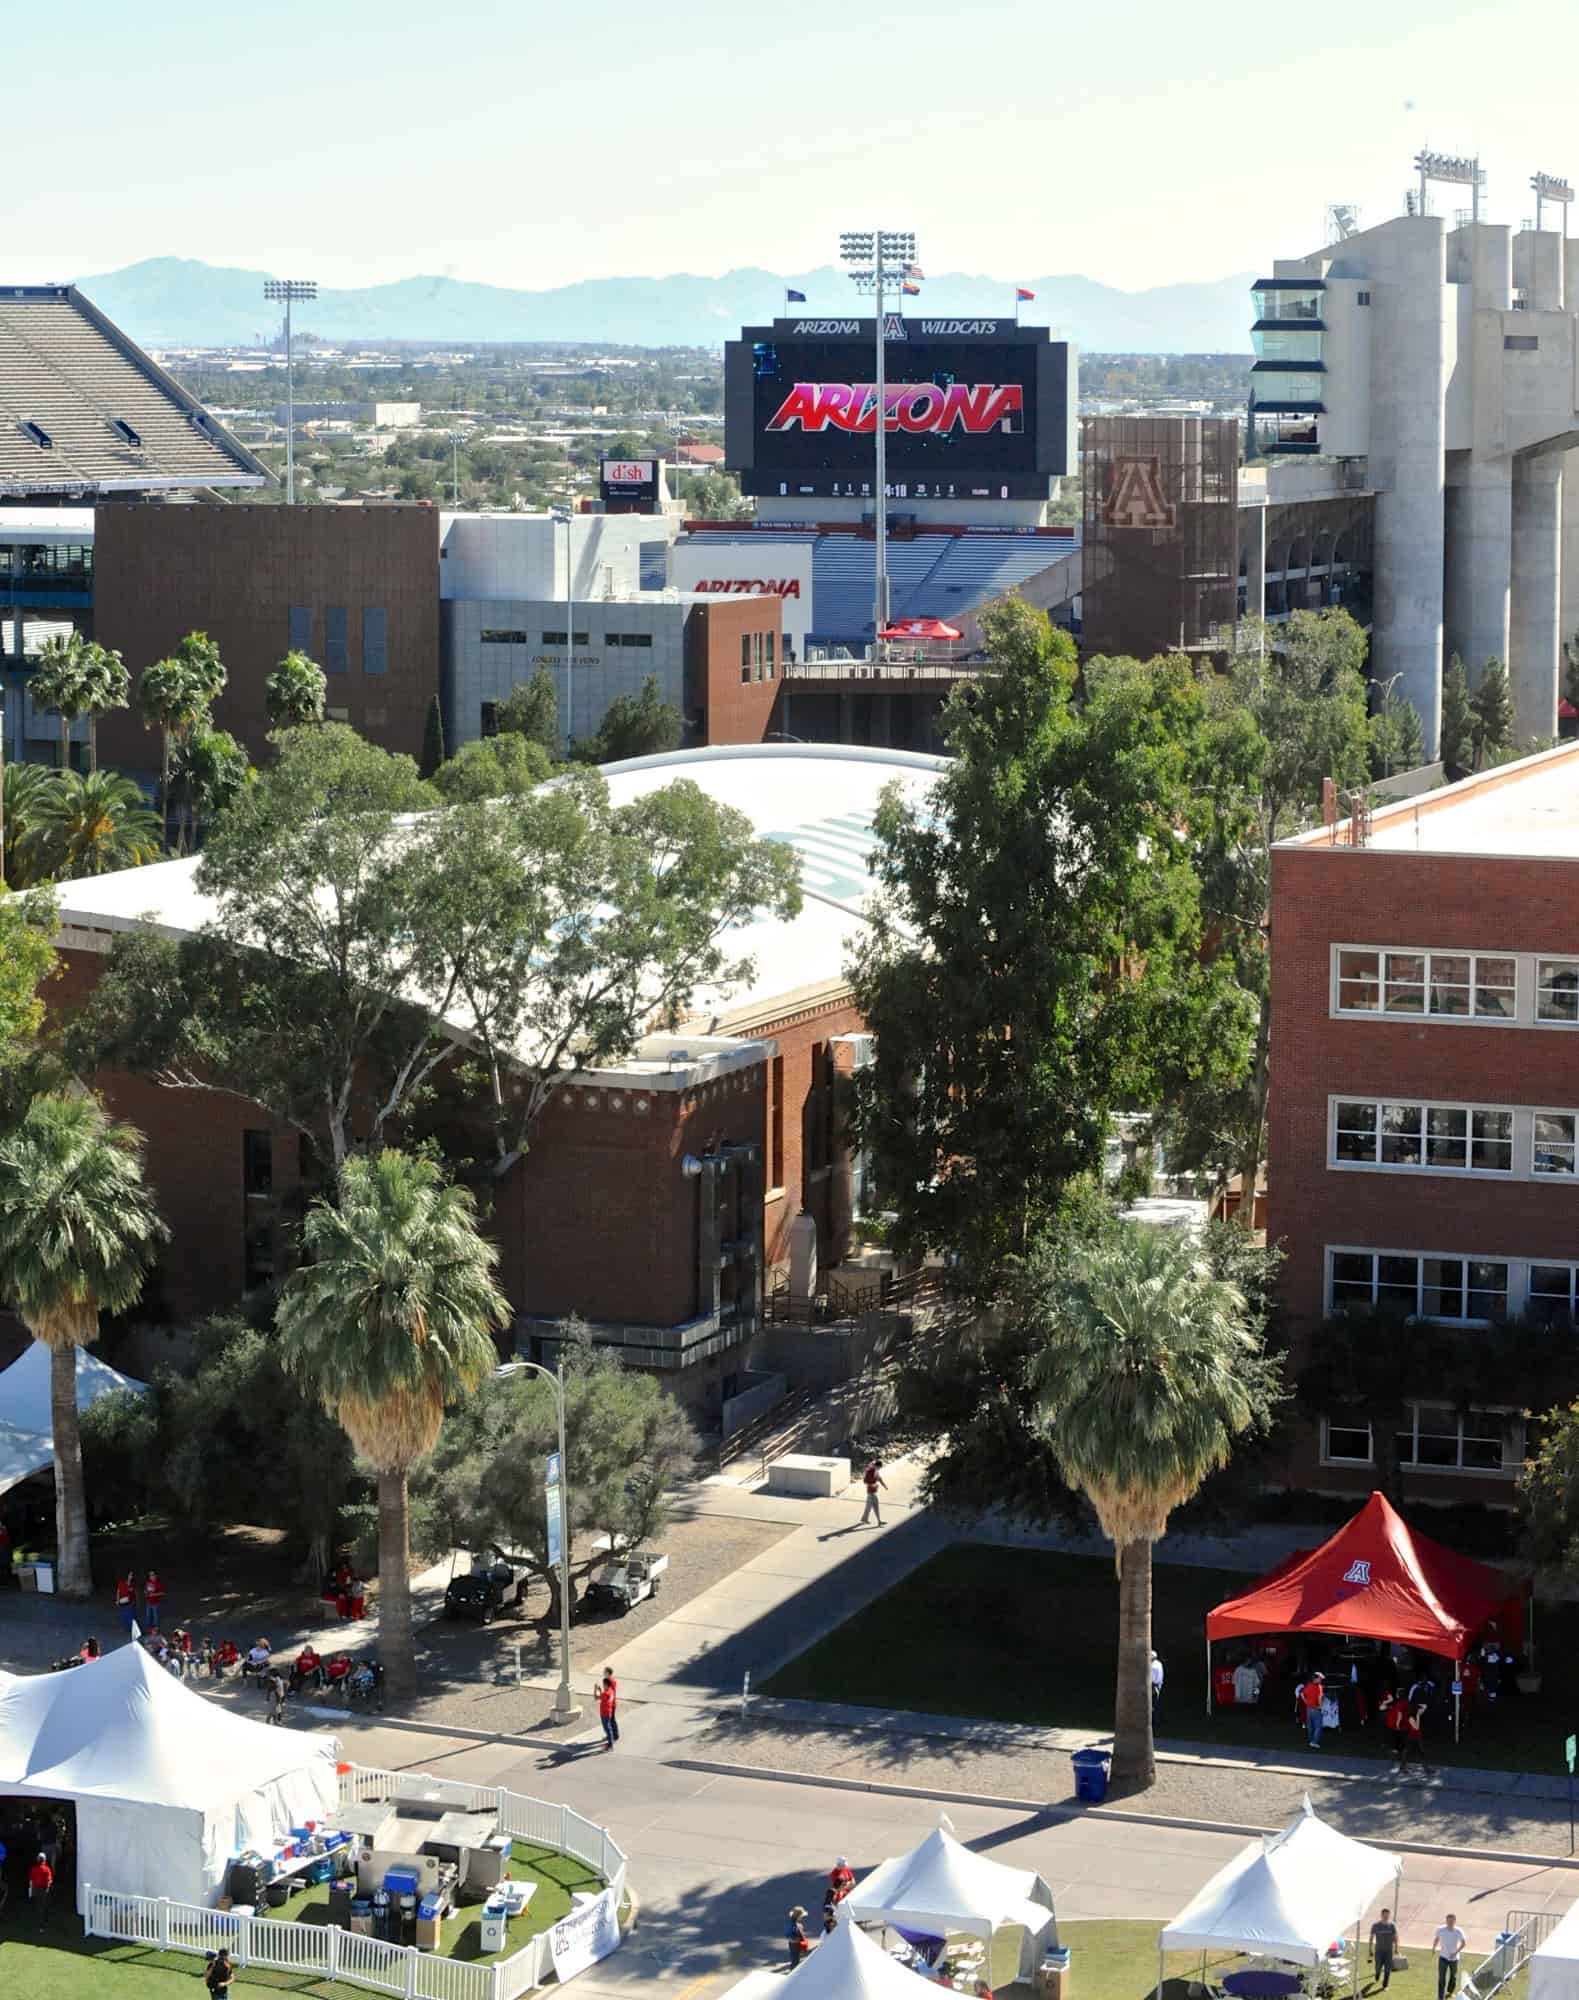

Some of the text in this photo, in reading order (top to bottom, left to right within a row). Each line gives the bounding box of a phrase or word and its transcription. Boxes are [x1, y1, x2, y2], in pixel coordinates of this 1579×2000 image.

[793, 321, 860, 334] ARIZONA
[921, 321, 997, 334] WILDCATS
[765, 383, 1025, 432] ARIZONA
[613, 464, 642, 480] dish
[1103, 455, 1176, 529] A
[694, 579, 801, 600] ARIZONA
[1344, 1560, 1370, 1585] A
